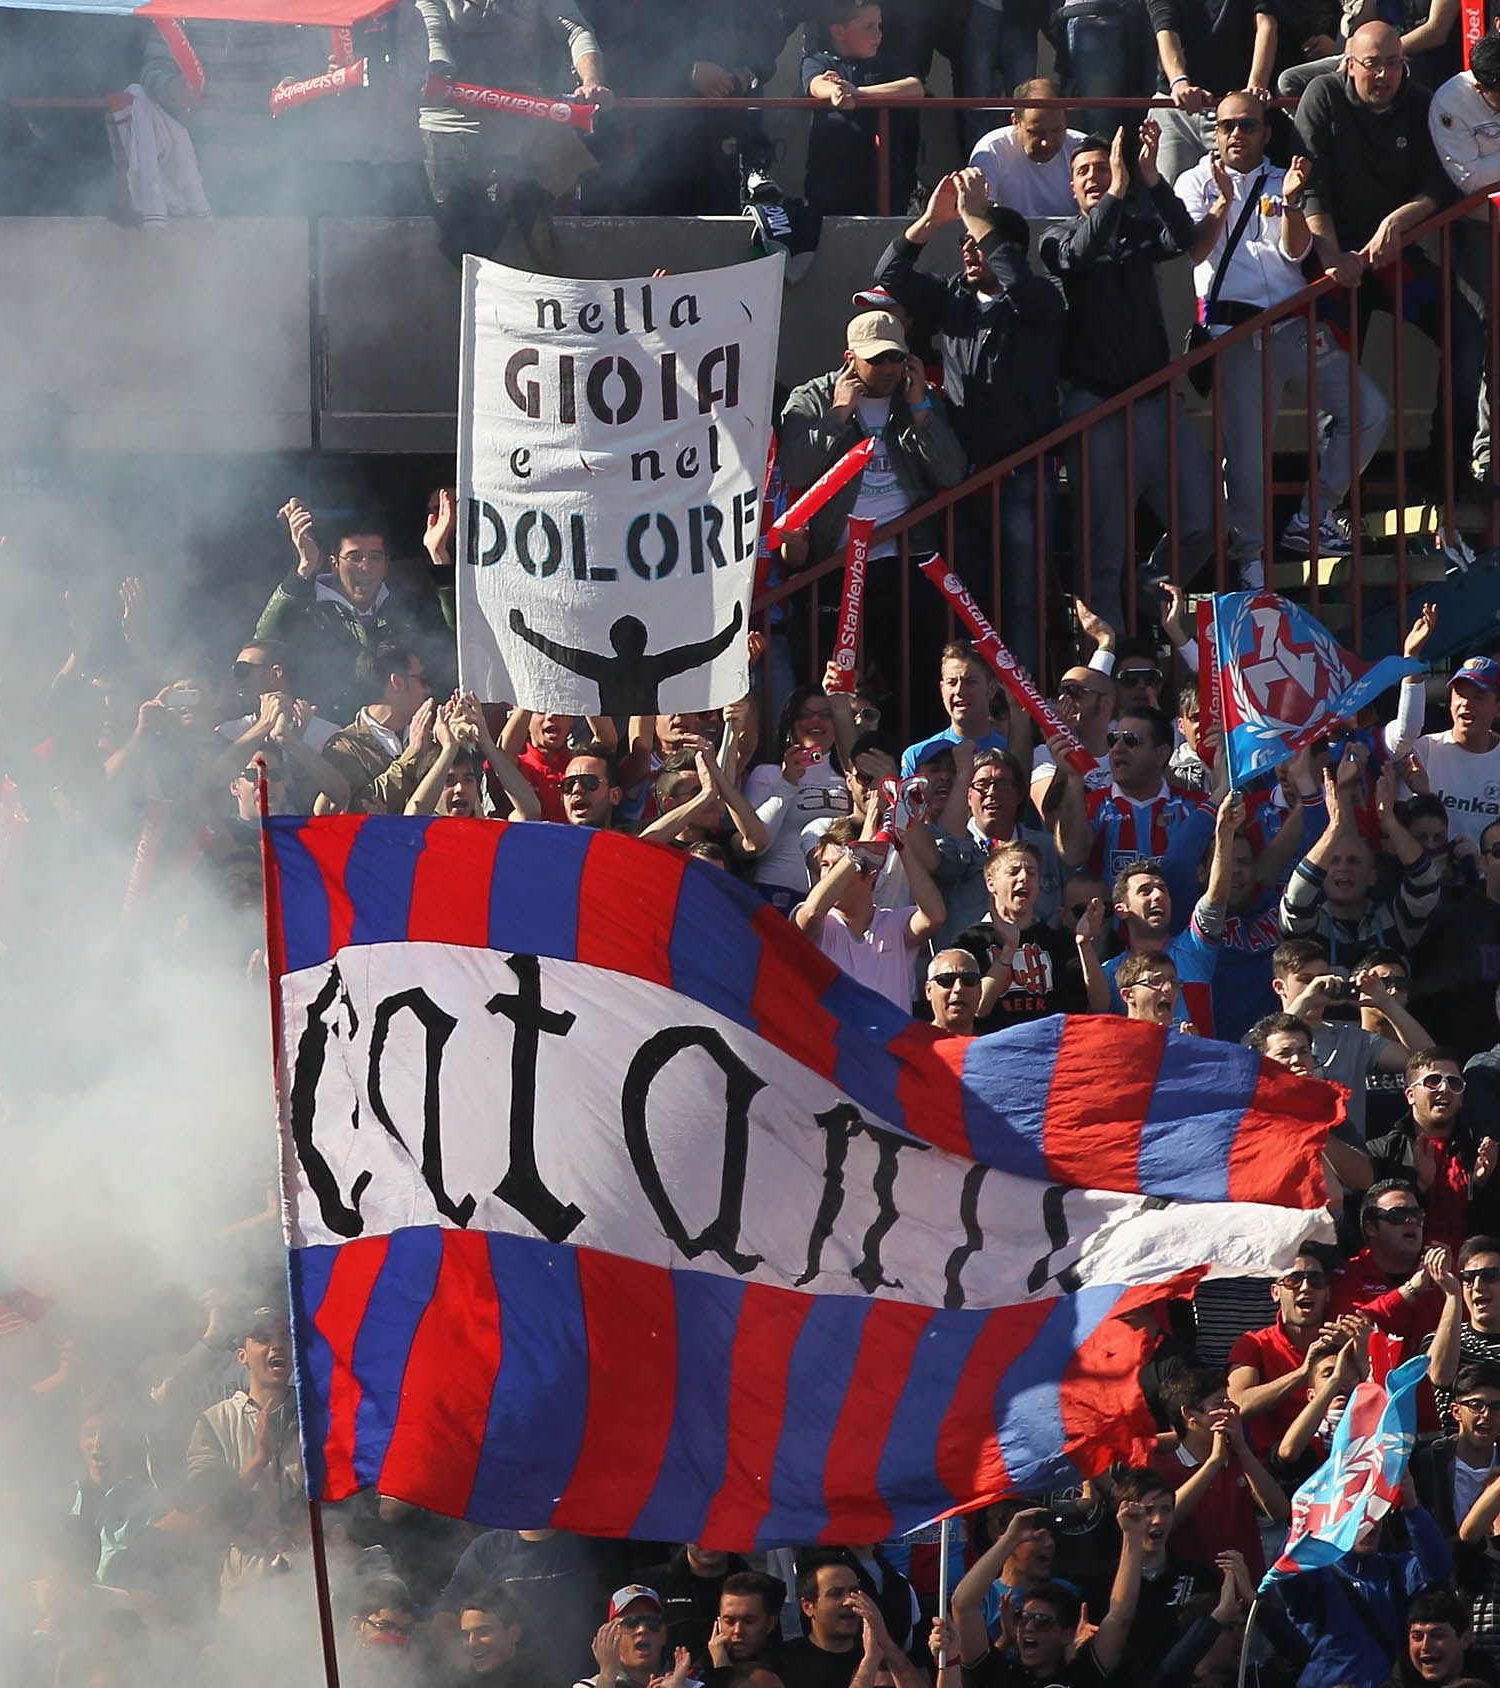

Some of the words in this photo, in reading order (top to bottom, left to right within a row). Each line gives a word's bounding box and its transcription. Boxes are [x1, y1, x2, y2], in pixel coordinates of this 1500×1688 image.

[445, 85, 549, 118] Stanleybet
[535, 284, 702, 335] nella
[504, 342, 741, 425] GIOIA
[509, 446, 532, 479] e
[630, 424, 722, 482] nel
[466, 486, 759, 582] DOLORE
[841, 538, 867, 647] Stanleybet
[1011, 667, 1086, 754] Stanleybet
